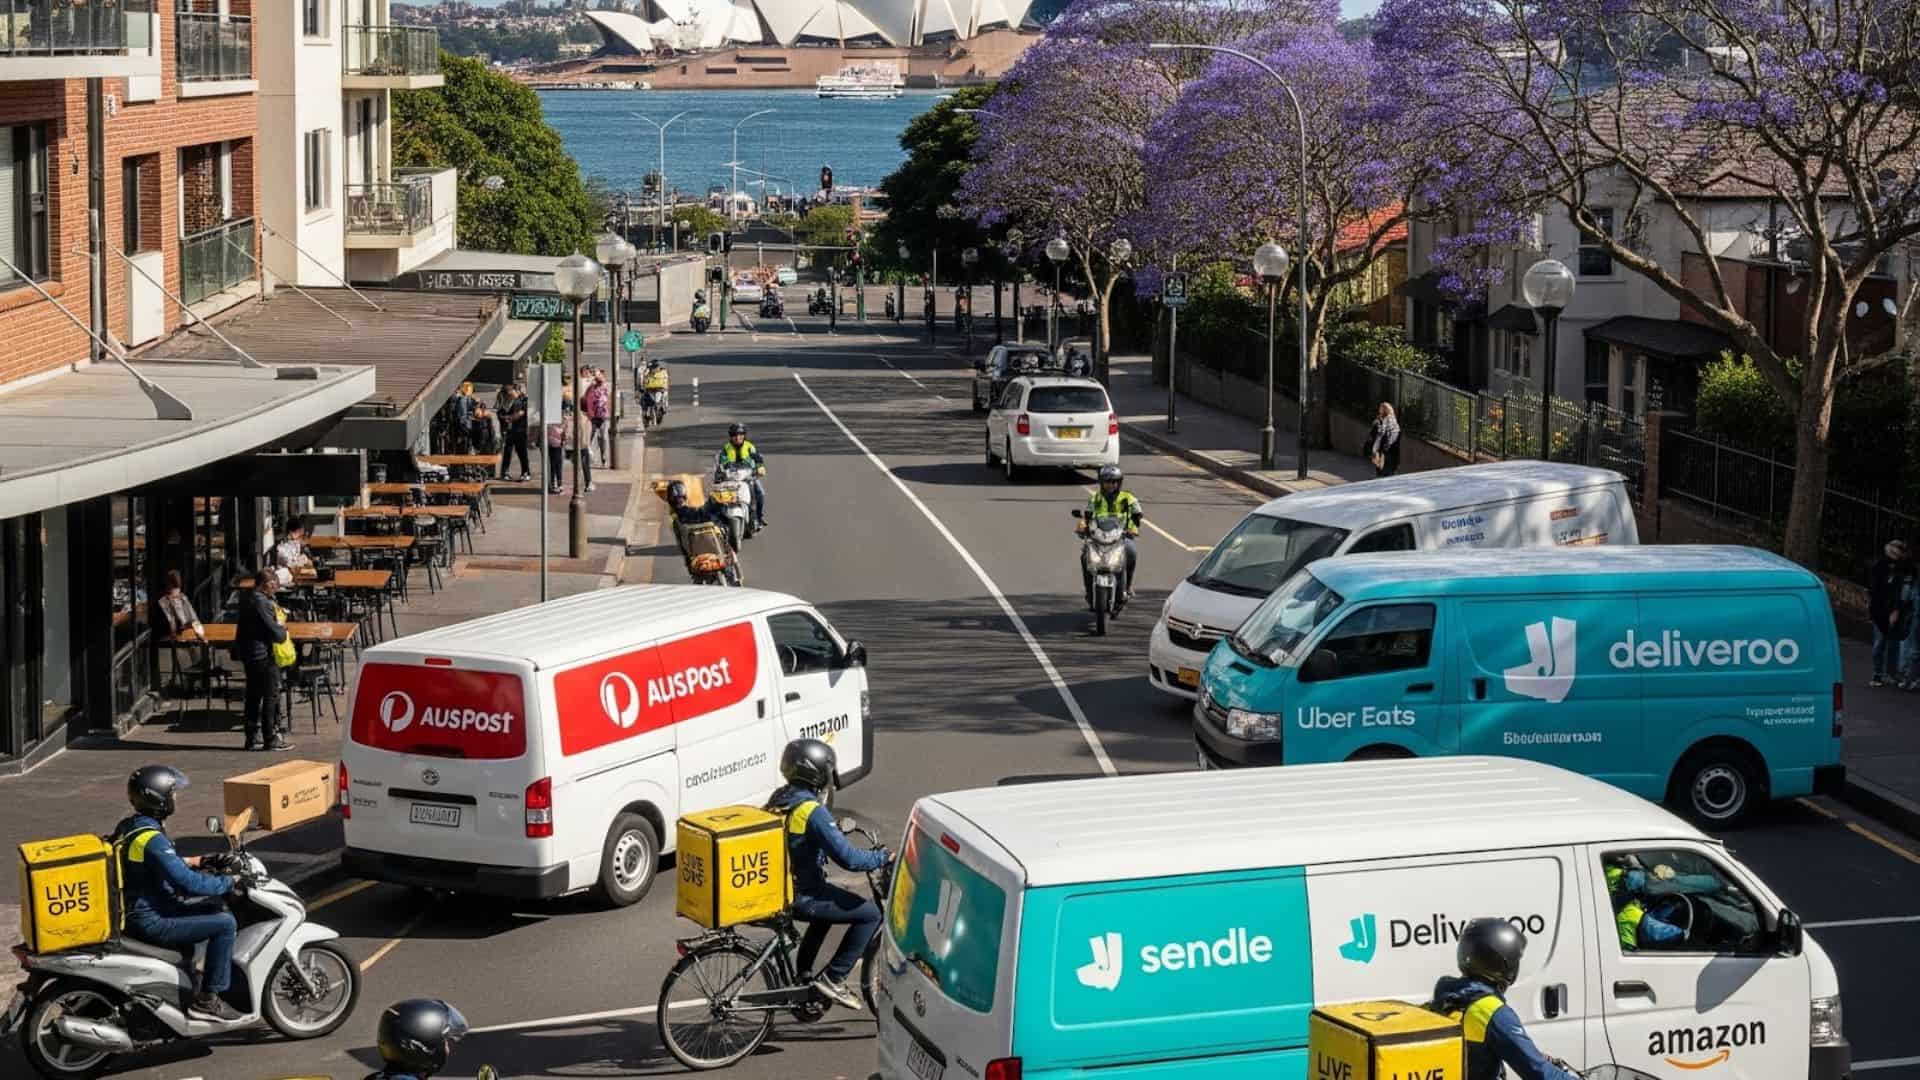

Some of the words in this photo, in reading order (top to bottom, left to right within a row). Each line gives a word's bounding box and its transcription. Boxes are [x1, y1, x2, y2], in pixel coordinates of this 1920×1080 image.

[1609, 629, 1799, 668] deliveroo
[1298, 706, 1356, 728] Uber
[1362, 704, 1416, 727] Eats
[731, 851, 769, 872] LIVE
[731, 868, 769, 888] OPS
[46, 881, 89, 900] LIVE
[48, 896, 90, 916] OPS
[1390, 913, 1545, 948] Delivoo
[1140, 927, 1272, 973] sendle
[1648, 1020, 1765, 1056] amazon
